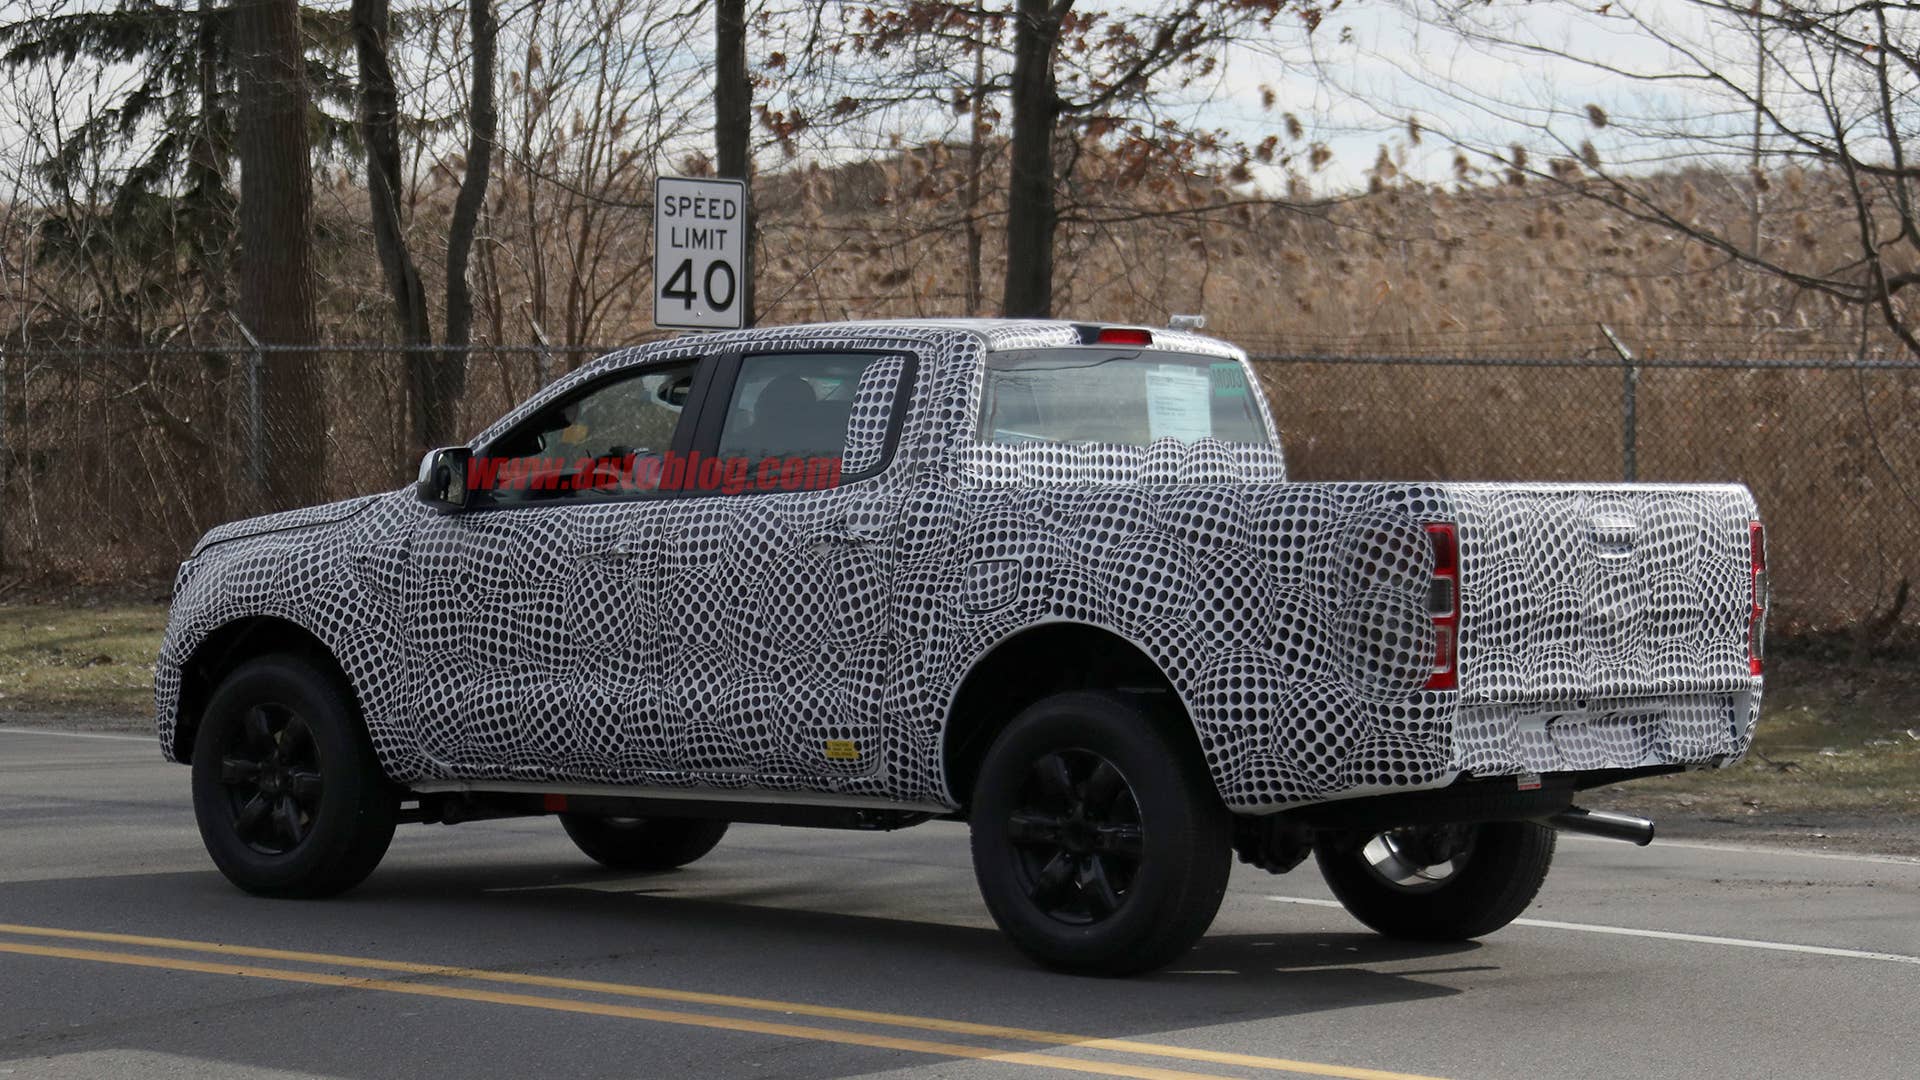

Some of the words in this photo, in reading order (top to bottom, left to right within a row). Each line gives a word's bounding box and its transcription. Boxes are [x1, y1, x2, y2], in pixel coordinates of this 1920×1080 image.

[664, 195, 737, 220] SPEED
[671, 226, 728, 250] LIMIT
[660, 258, 736, 313] 40
